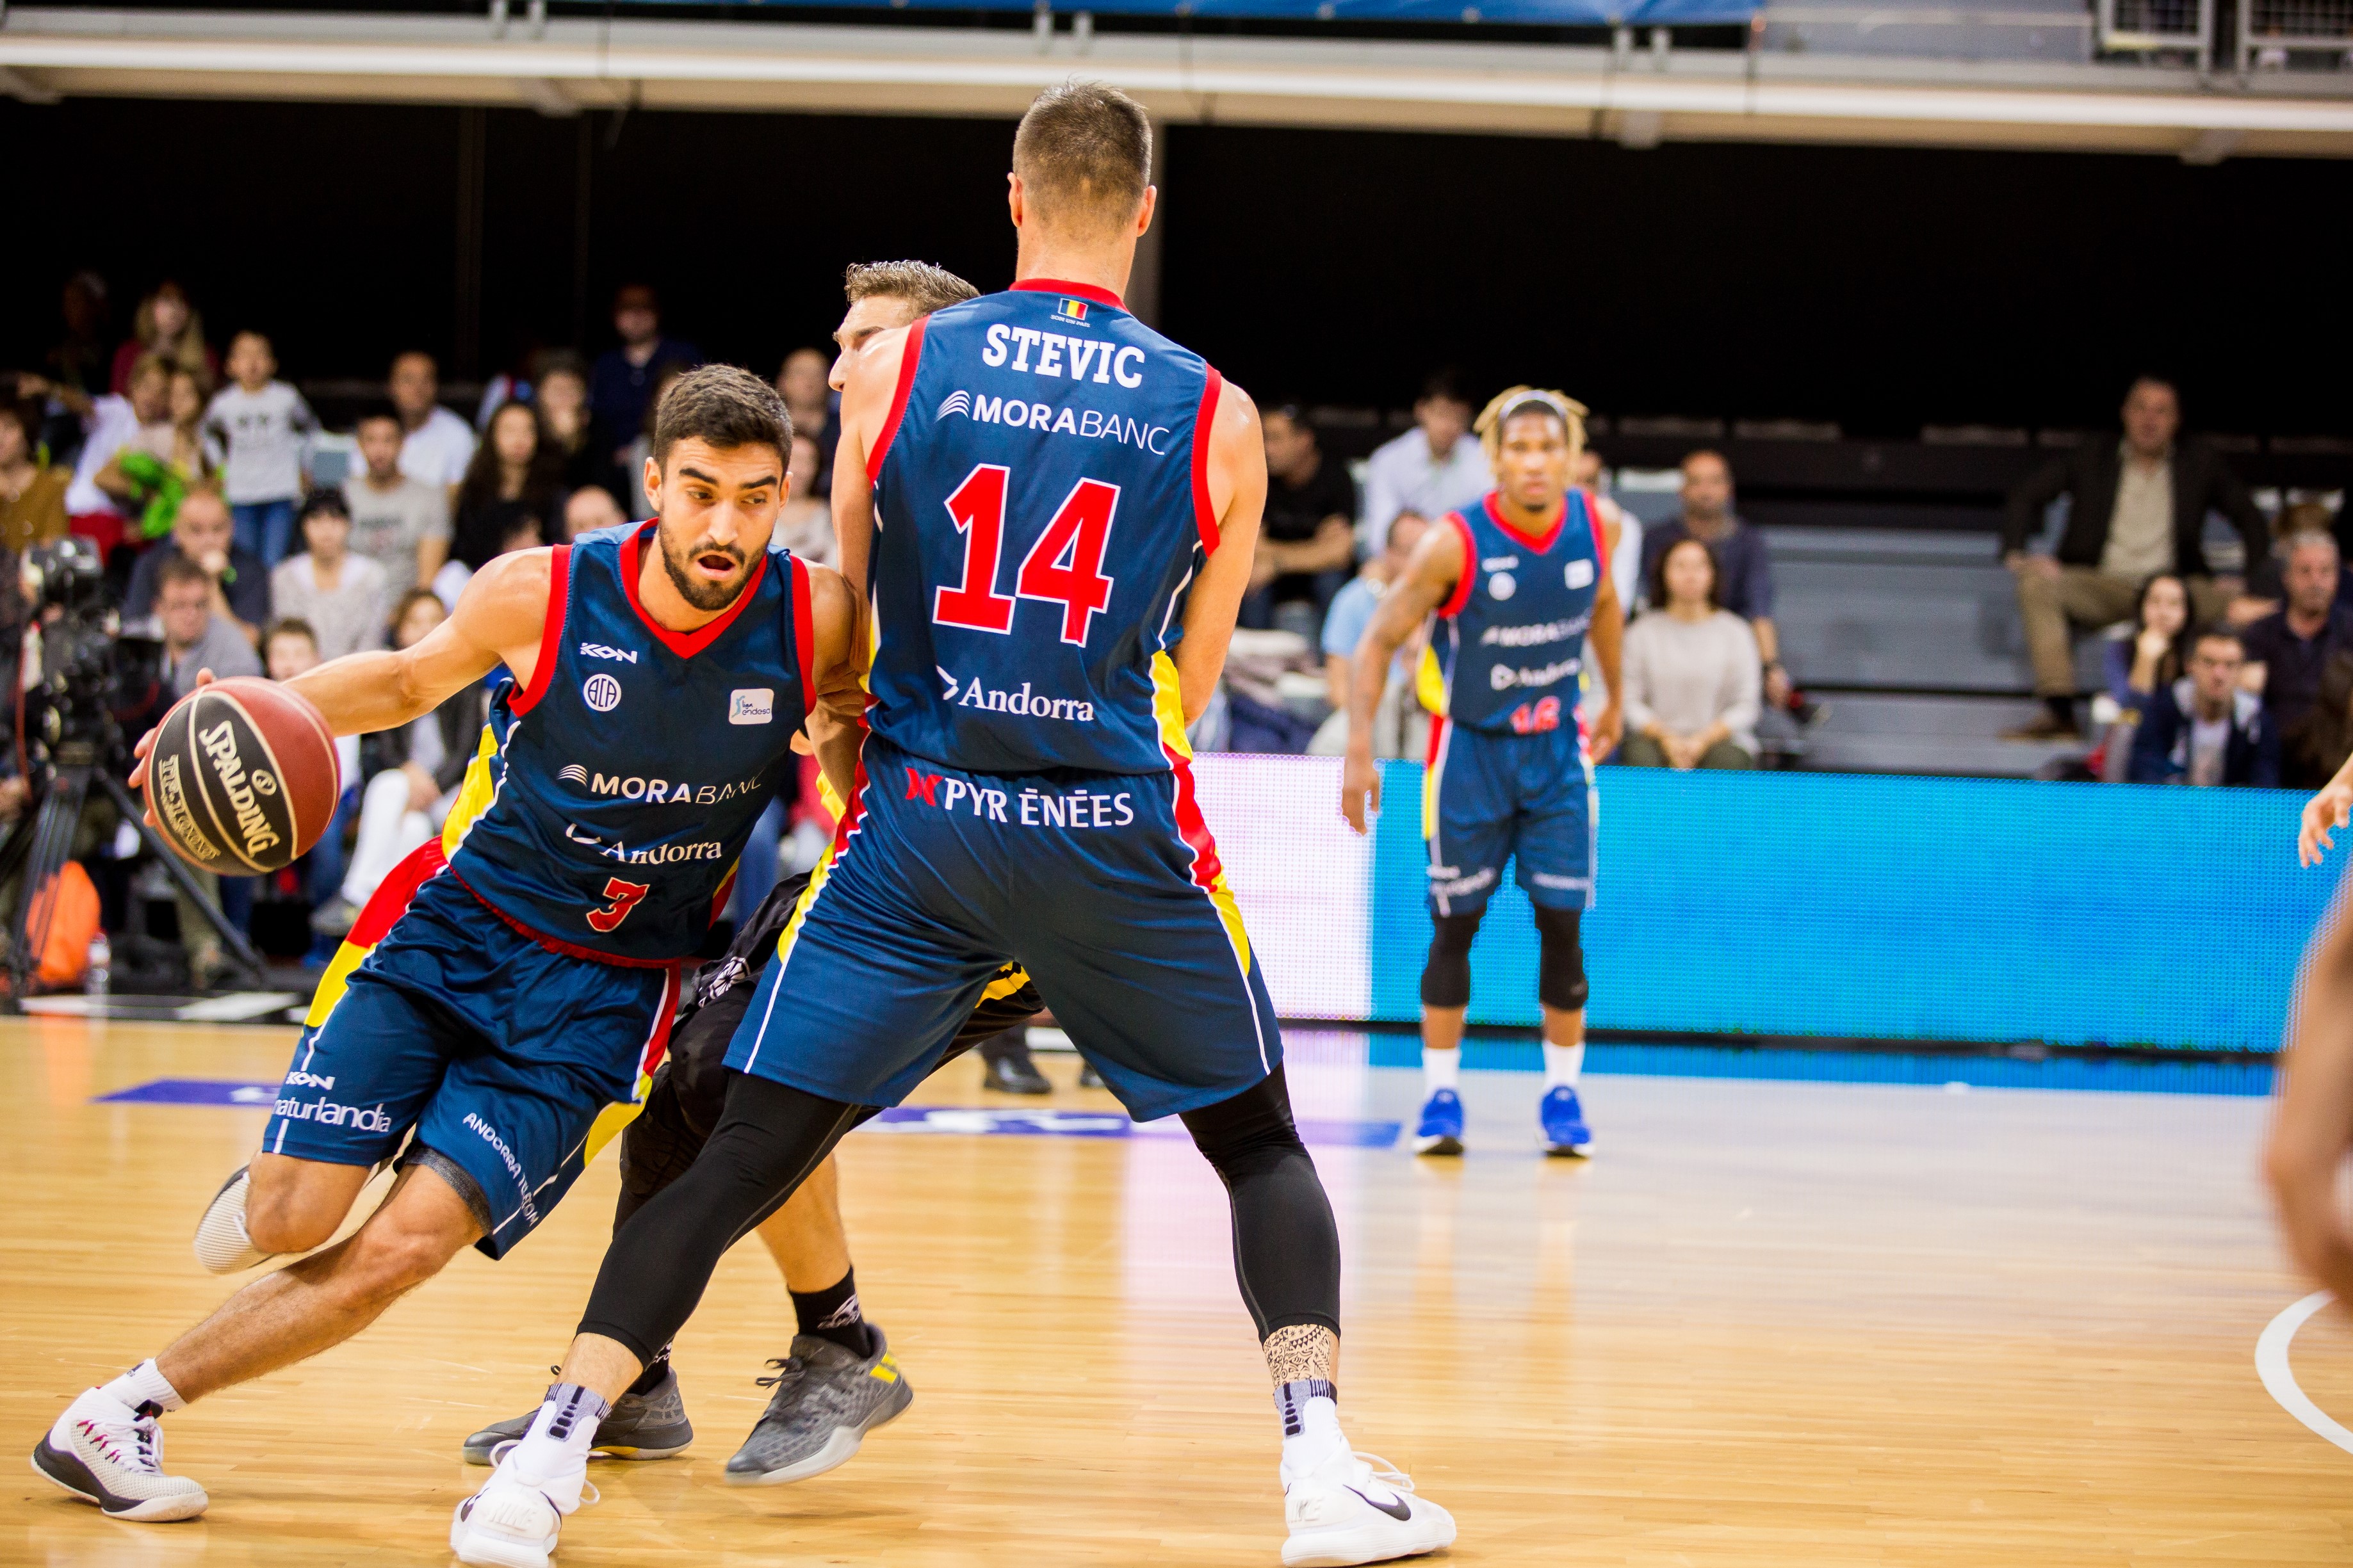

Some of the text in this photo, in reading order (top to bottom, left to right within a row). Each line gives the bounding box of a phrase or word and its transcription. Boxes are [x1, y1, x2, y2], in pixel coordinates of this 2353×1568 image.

[982, 323, 1146, 389] STEVIC
[972, 393, 1170, 455] MORABANC
[932, 462, 1121, 649] 14
[742, 707, 771, 716] endesa
[958, 676, 1095, 722] Andorra
[199, 720, 281, 859] SPALDING
[590, 766, 767, 804] MORABANC
[599, 840, 723, 865] Andorra
[585, 876, 651, 933] 3
[462, 1112, 522, 1179] ANDORRA
